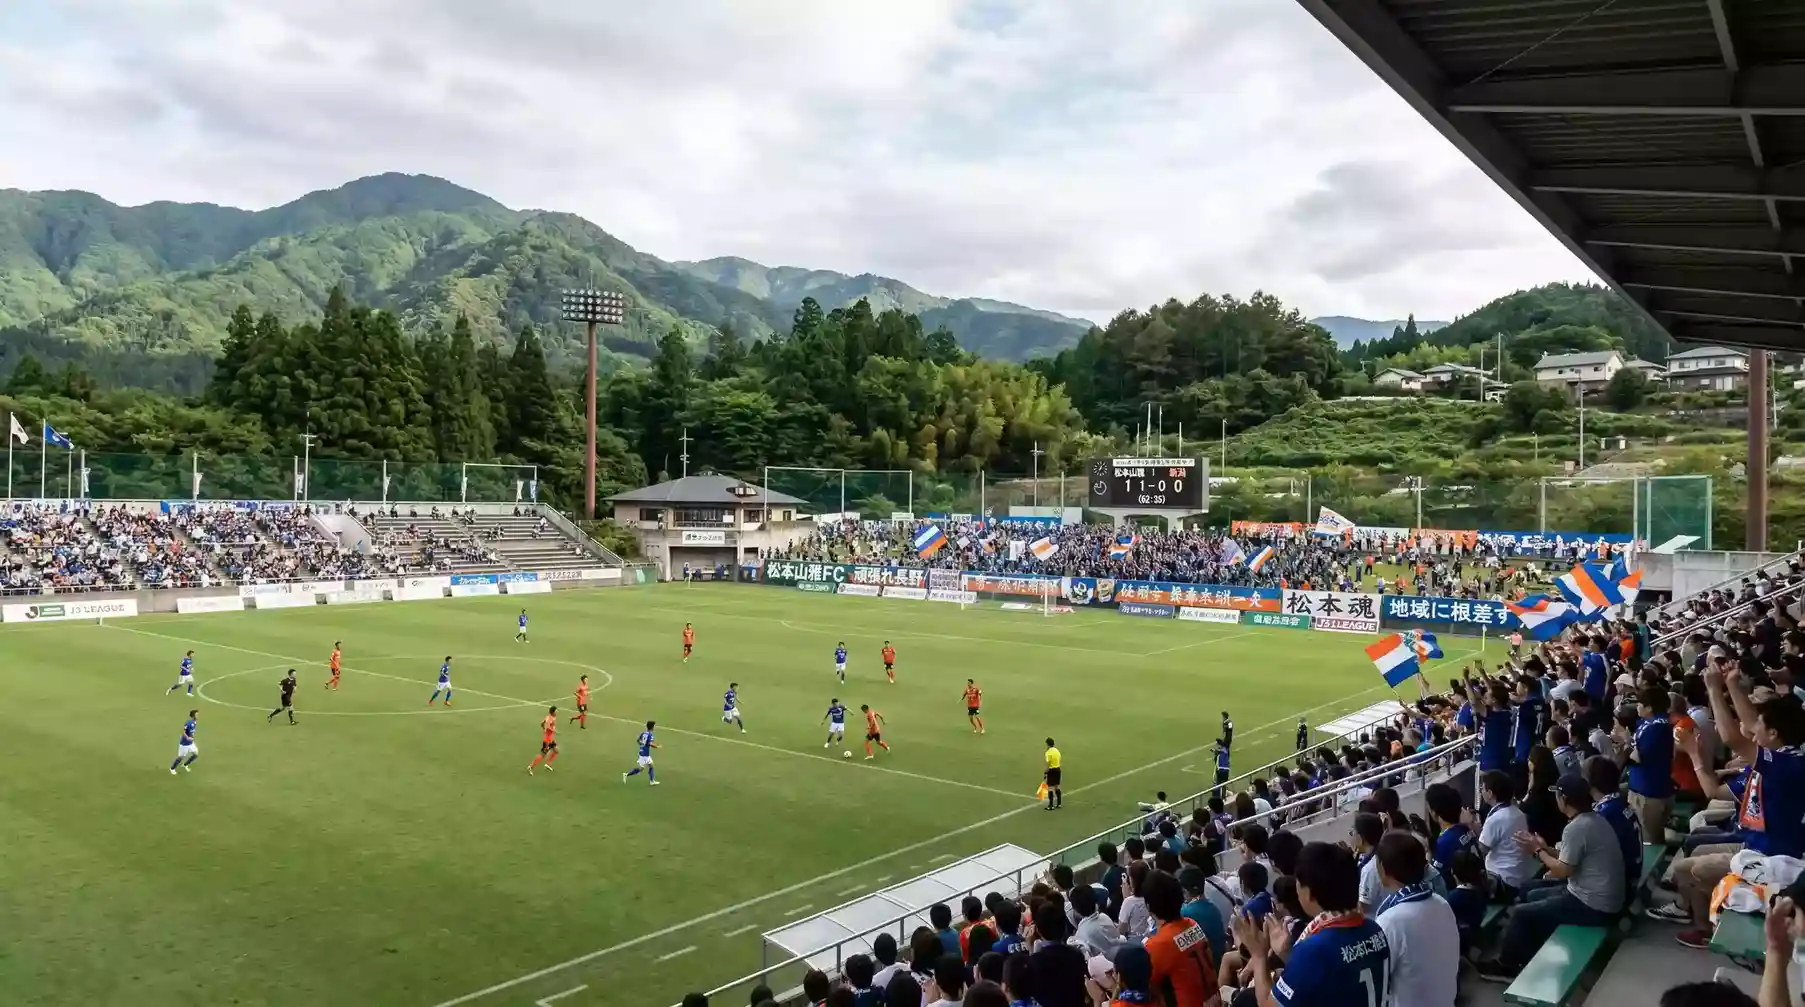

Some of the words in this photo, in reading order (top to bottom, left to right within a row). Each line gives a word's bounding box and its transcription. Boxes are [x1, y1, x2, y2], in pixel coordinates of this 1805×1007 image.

[767, 562, 845, 583] 松本山雅FC
[854, 566, 924, 587] 頑張れ長野
[1286, 592, 1376, 619] 松本魂
[1389, 598, 1512, 624] 地域に根差す
